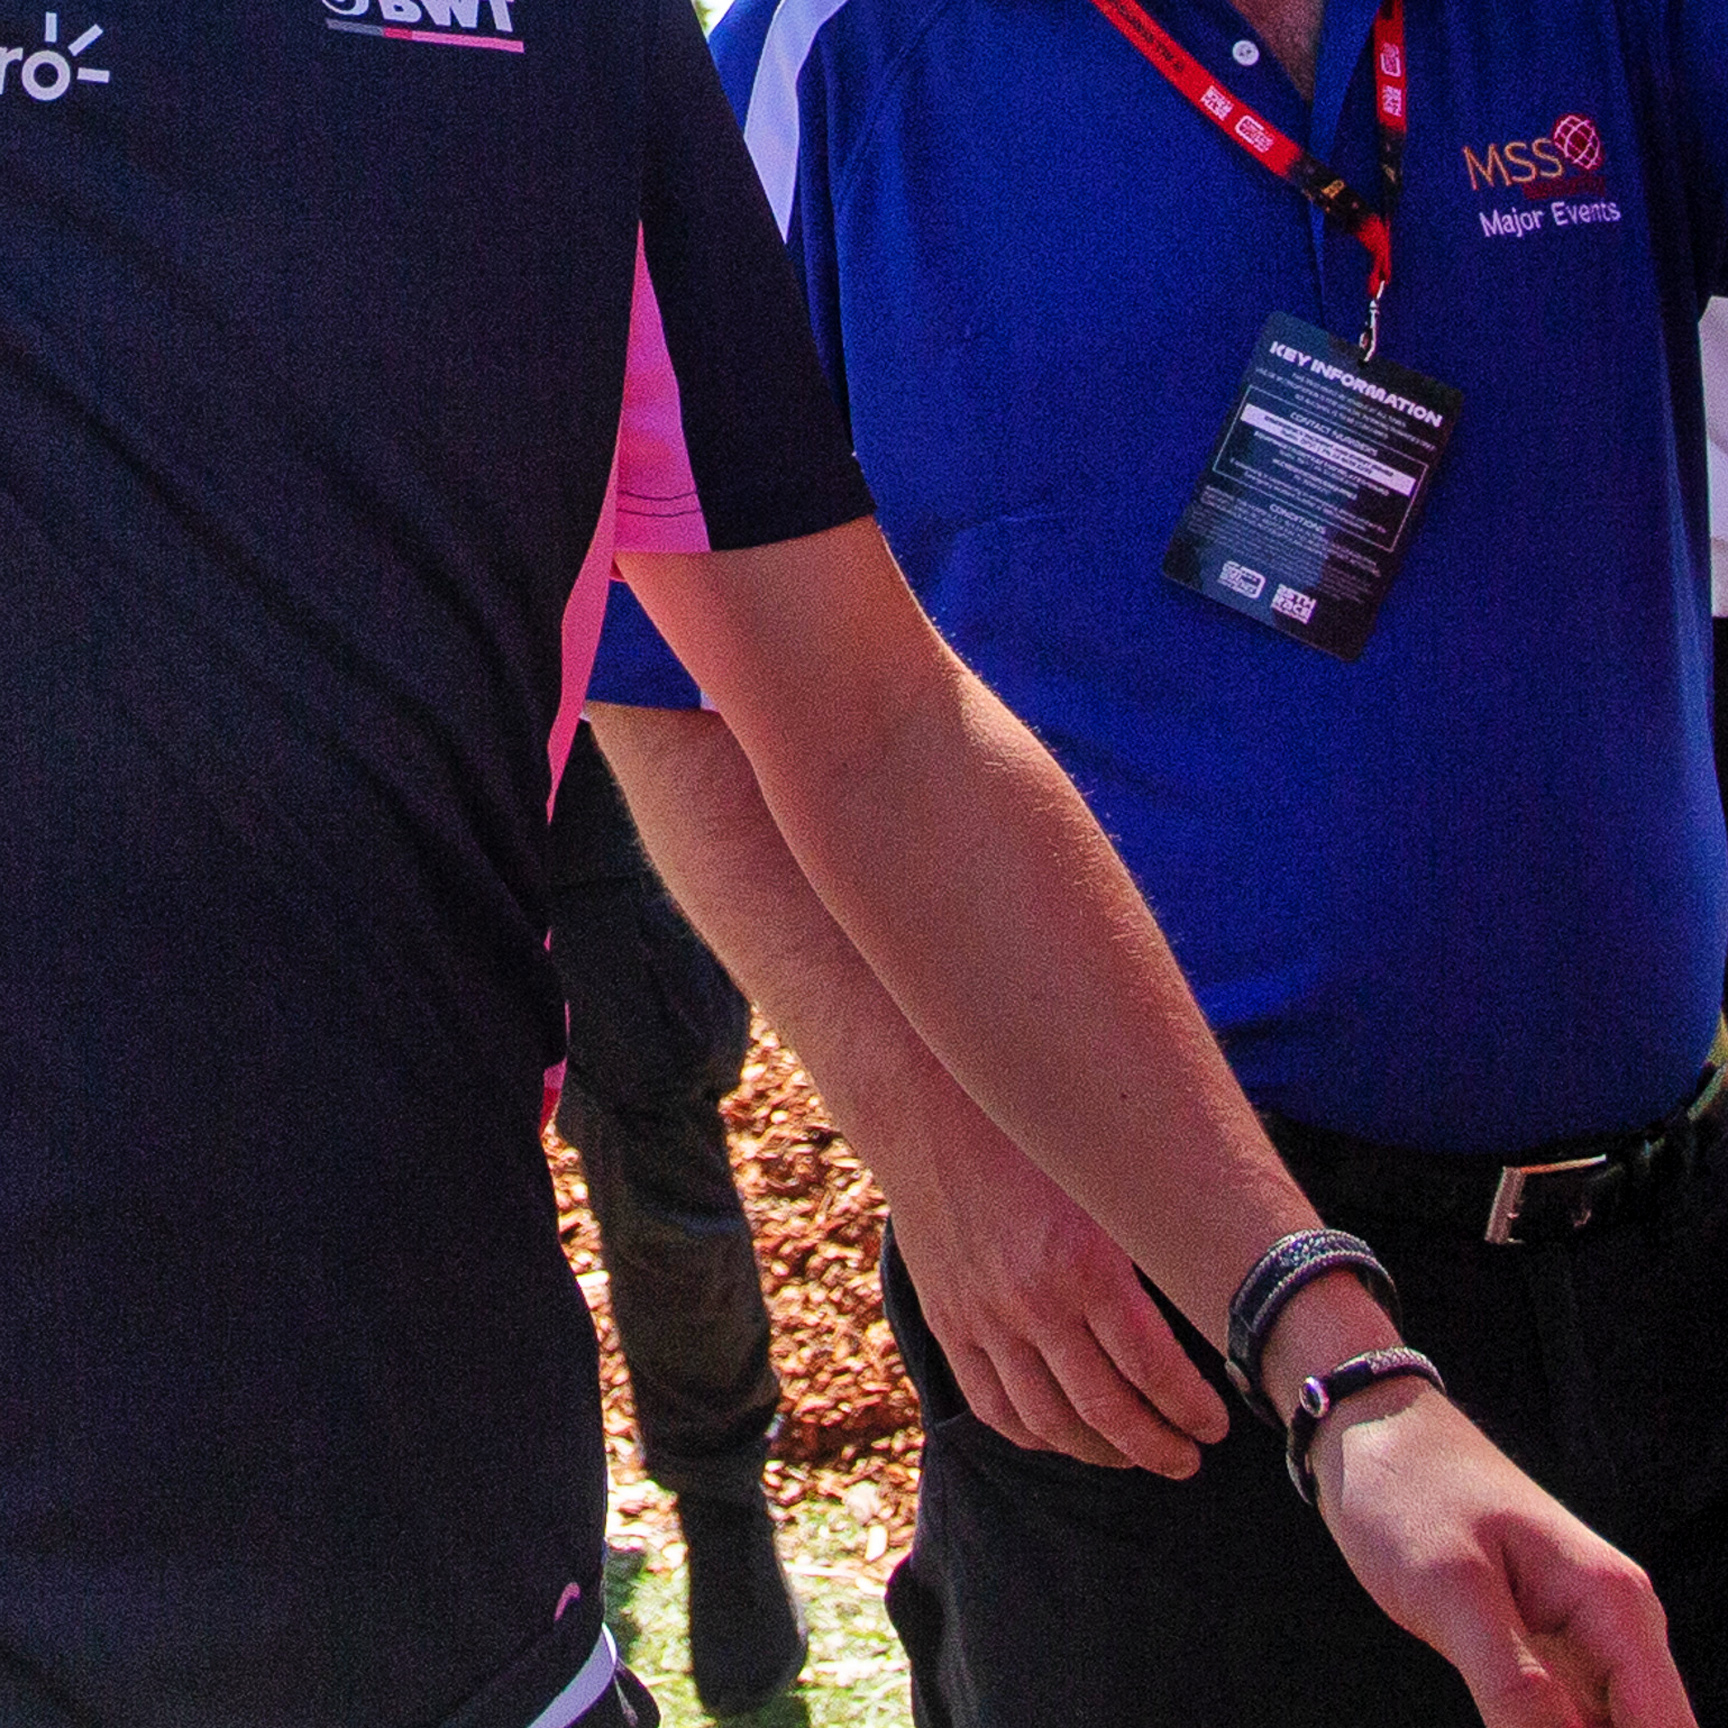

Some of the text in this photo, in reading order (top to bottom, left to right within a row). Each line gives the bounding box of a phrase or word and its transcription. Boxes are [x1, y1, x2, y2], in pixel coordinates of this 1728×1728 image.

[1462, 138, 1565, 191] MSS
[1479, 201, 1621, 238] Major Events
[1268, 339, 1312, 369] KEY
[1309, 358, 1444, 428] INFORMATION
